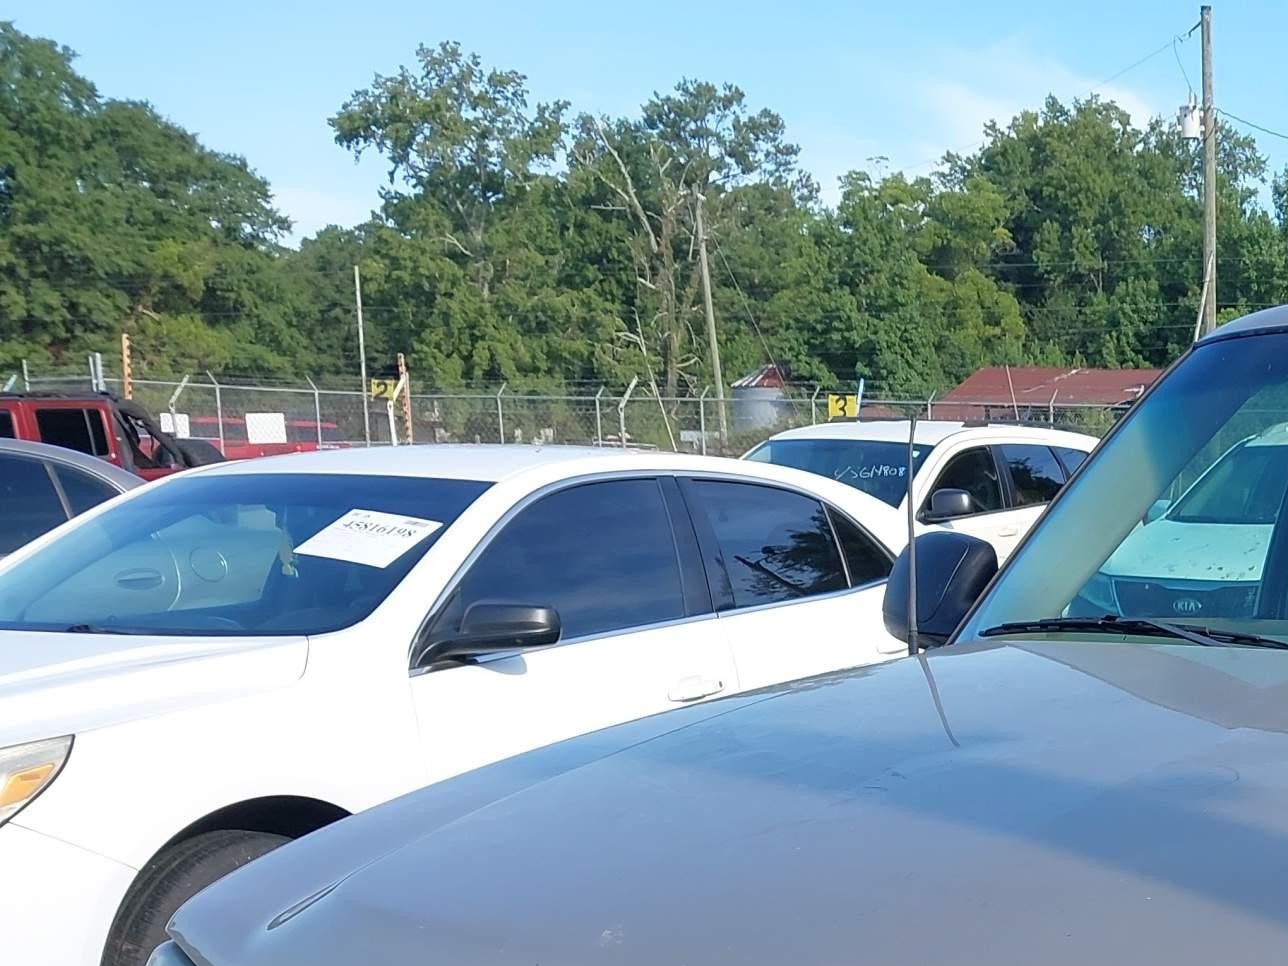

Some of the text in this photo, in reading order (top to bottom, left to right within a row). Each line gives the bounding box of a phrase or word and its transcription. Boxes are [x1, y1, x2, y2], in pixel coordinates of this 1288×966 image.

[374, 381, 390, 399] 2
[835, 395, 848, 418] 3
[343, 520, 417, 537] 45816198
